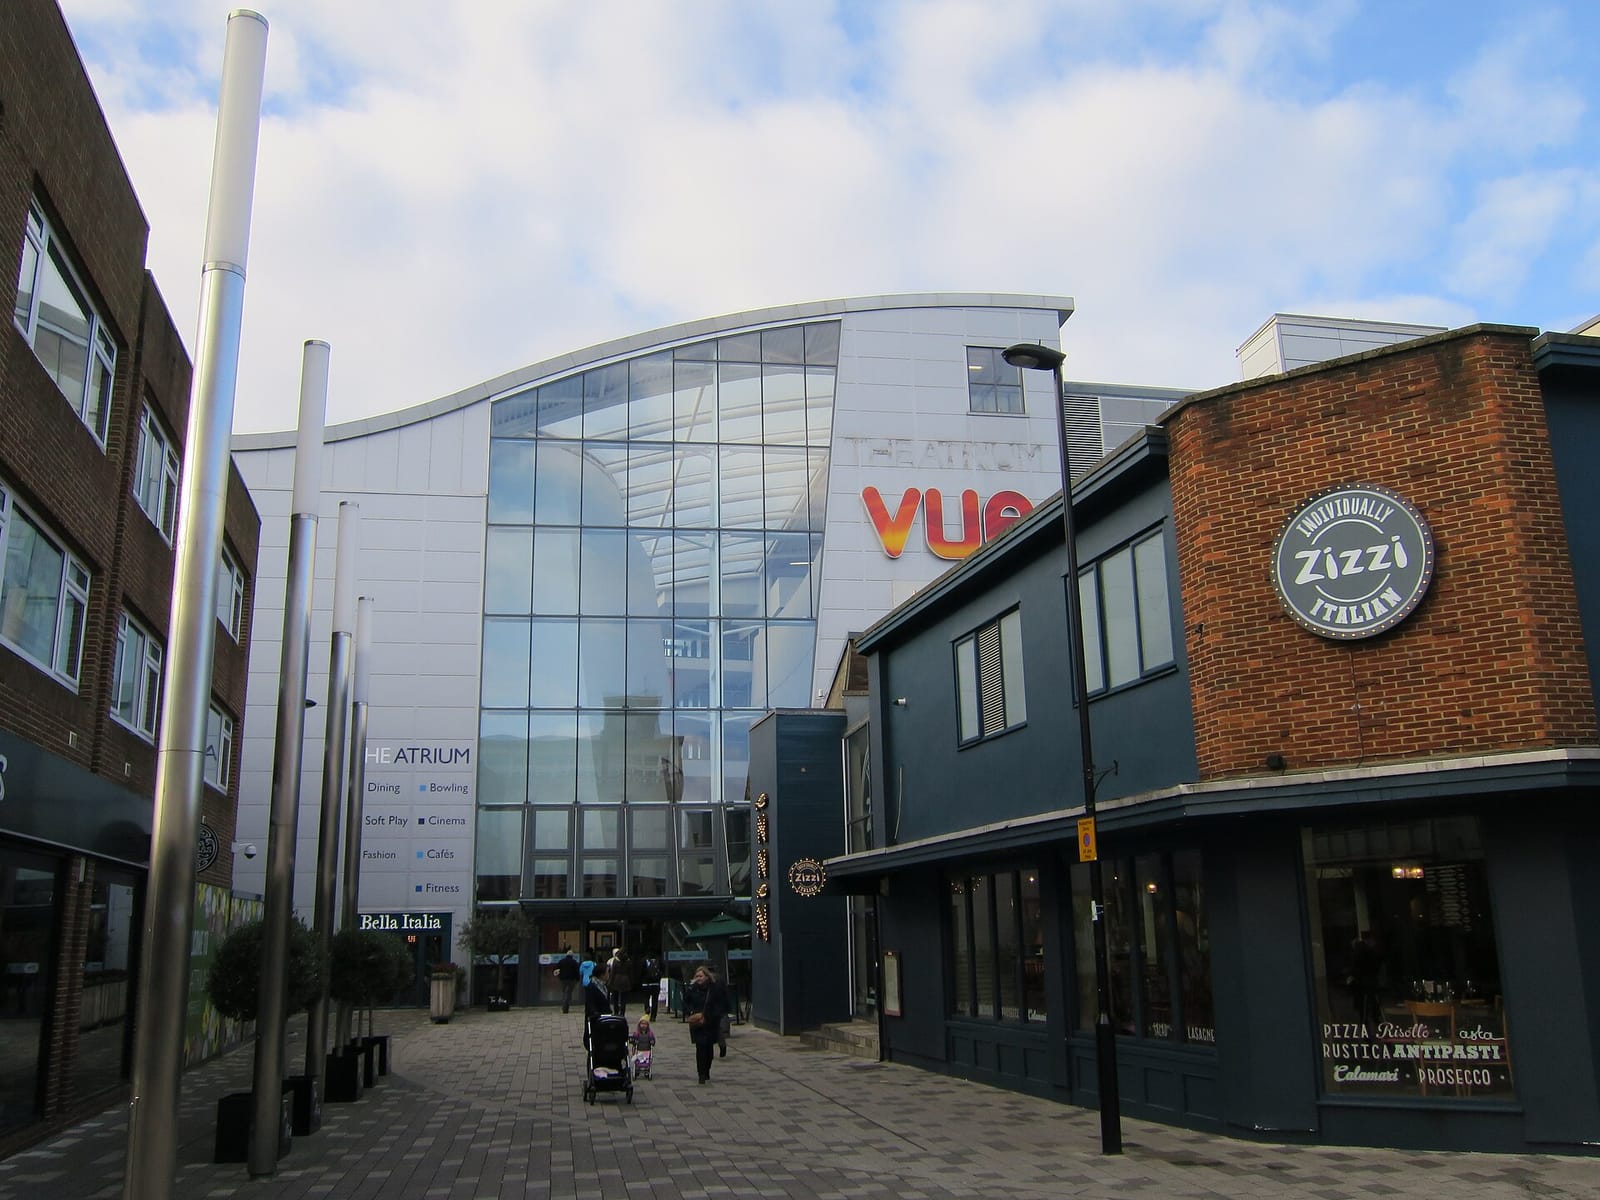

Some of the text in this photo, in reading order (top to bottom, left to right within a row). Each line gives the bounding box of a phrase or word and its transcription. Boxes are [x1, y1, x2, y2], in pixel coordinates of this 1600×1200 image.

[1296, 498, 1395, 538] INDIVIDUALLY
[1294, 535, 1408, 585] Zizzi
[1310, 586, 1402, 624] ITALIAN
[365, 747, 470, 764] HE ATRIUM
[367, 782, 401, 794] Dining
[430, 782, 469, 794] Bowling
[365, 815, 409, 828] Soft Play
[428, 815, 466, 826] Cinema
[362, 850, 396, 859] Fashion
[426, 848, 455, 859] Cafés
[425, 883, 460, 893] Fitness
[359, 914, 442, 930] Bella Italia
[1187, 1026, 1215, 1042] LASAGNE
[1323, 1022, 1505, 1041] PIZZA Risotto asta
[1323, 1044, 1501, 1060] RUSTICA ANTIPASTI
[1333, 1064, 1491, 1086] Calamari PROSECCO
